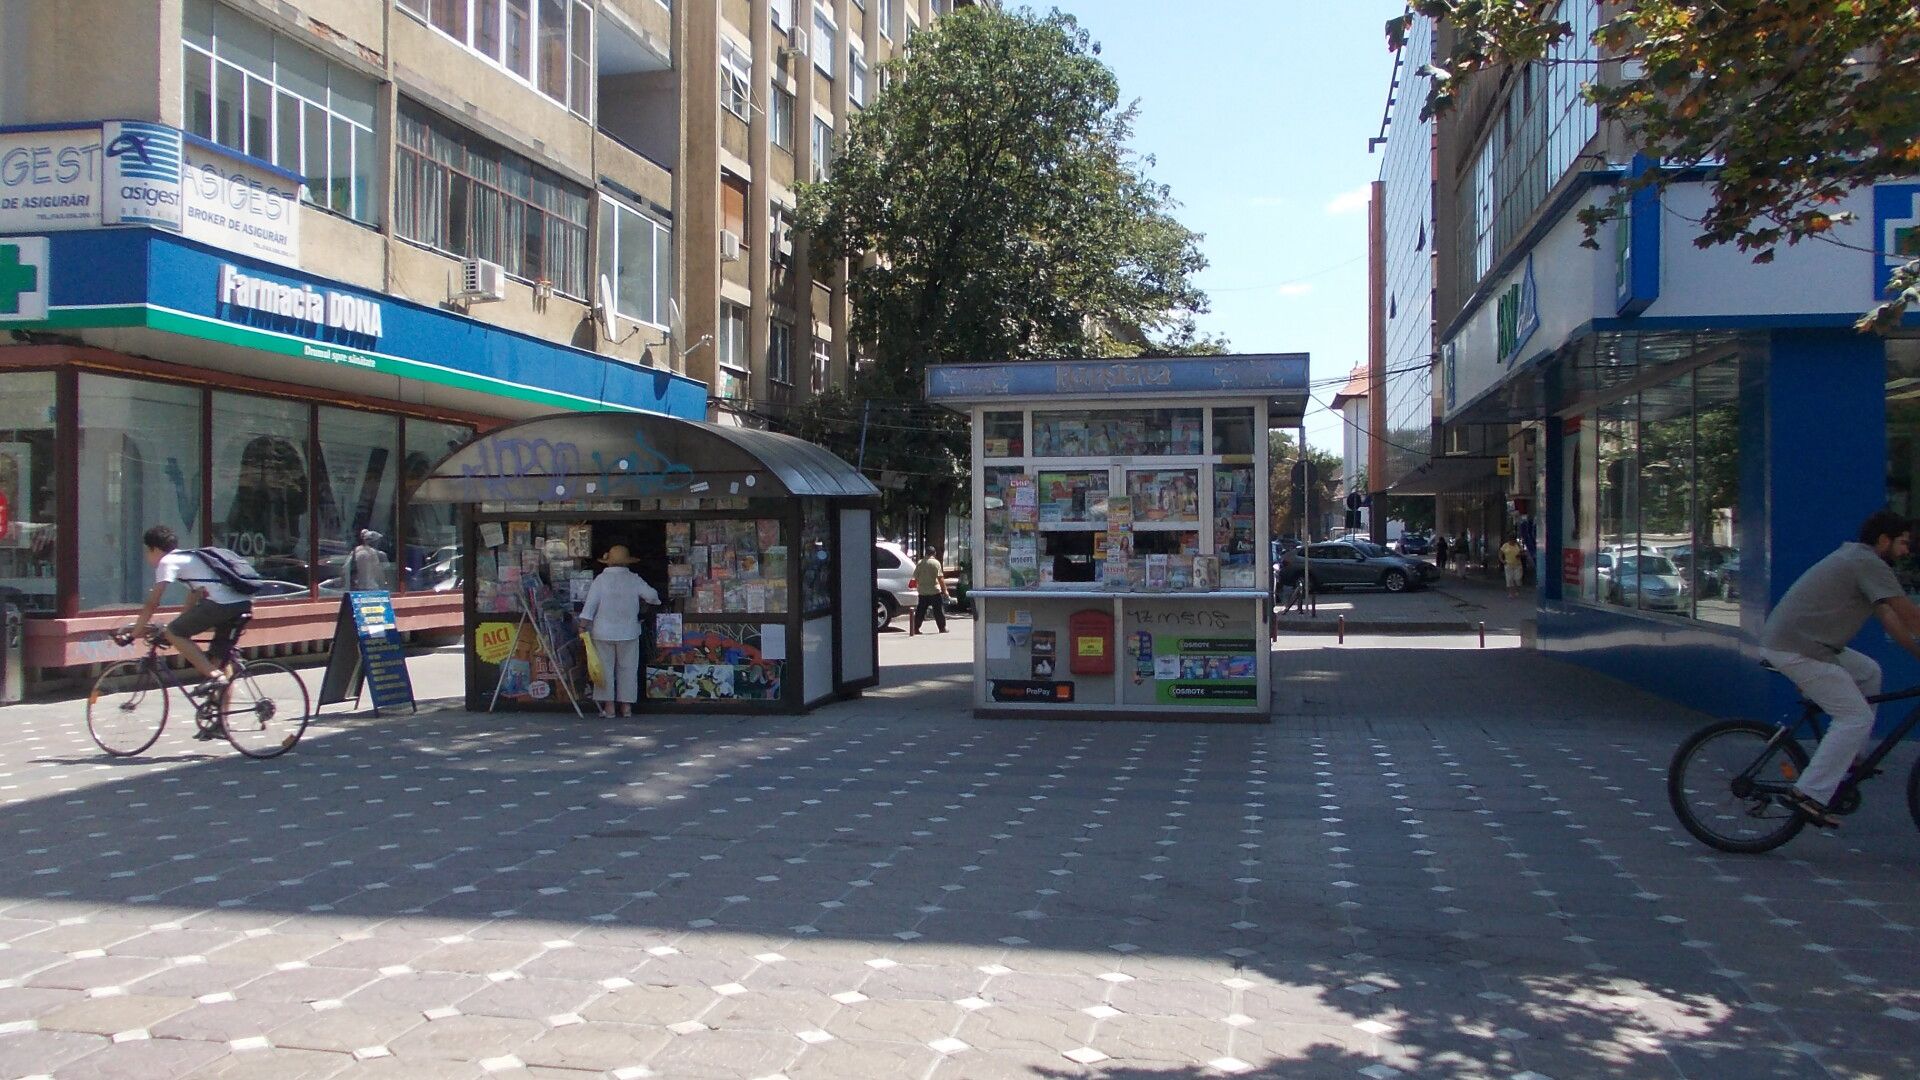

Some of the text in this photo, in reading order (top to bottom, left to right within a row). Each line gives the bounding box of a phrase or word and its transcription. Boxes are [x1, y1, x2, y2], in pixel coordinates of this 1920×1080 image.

[121, 182, 179, 206] asigest
[187, 206, 225, 227] BROKER
[228, 218, 240, 231] DE
[219, 263, 383, 338] Farmacia DONA
[482, 627, 510, 647] AICI
